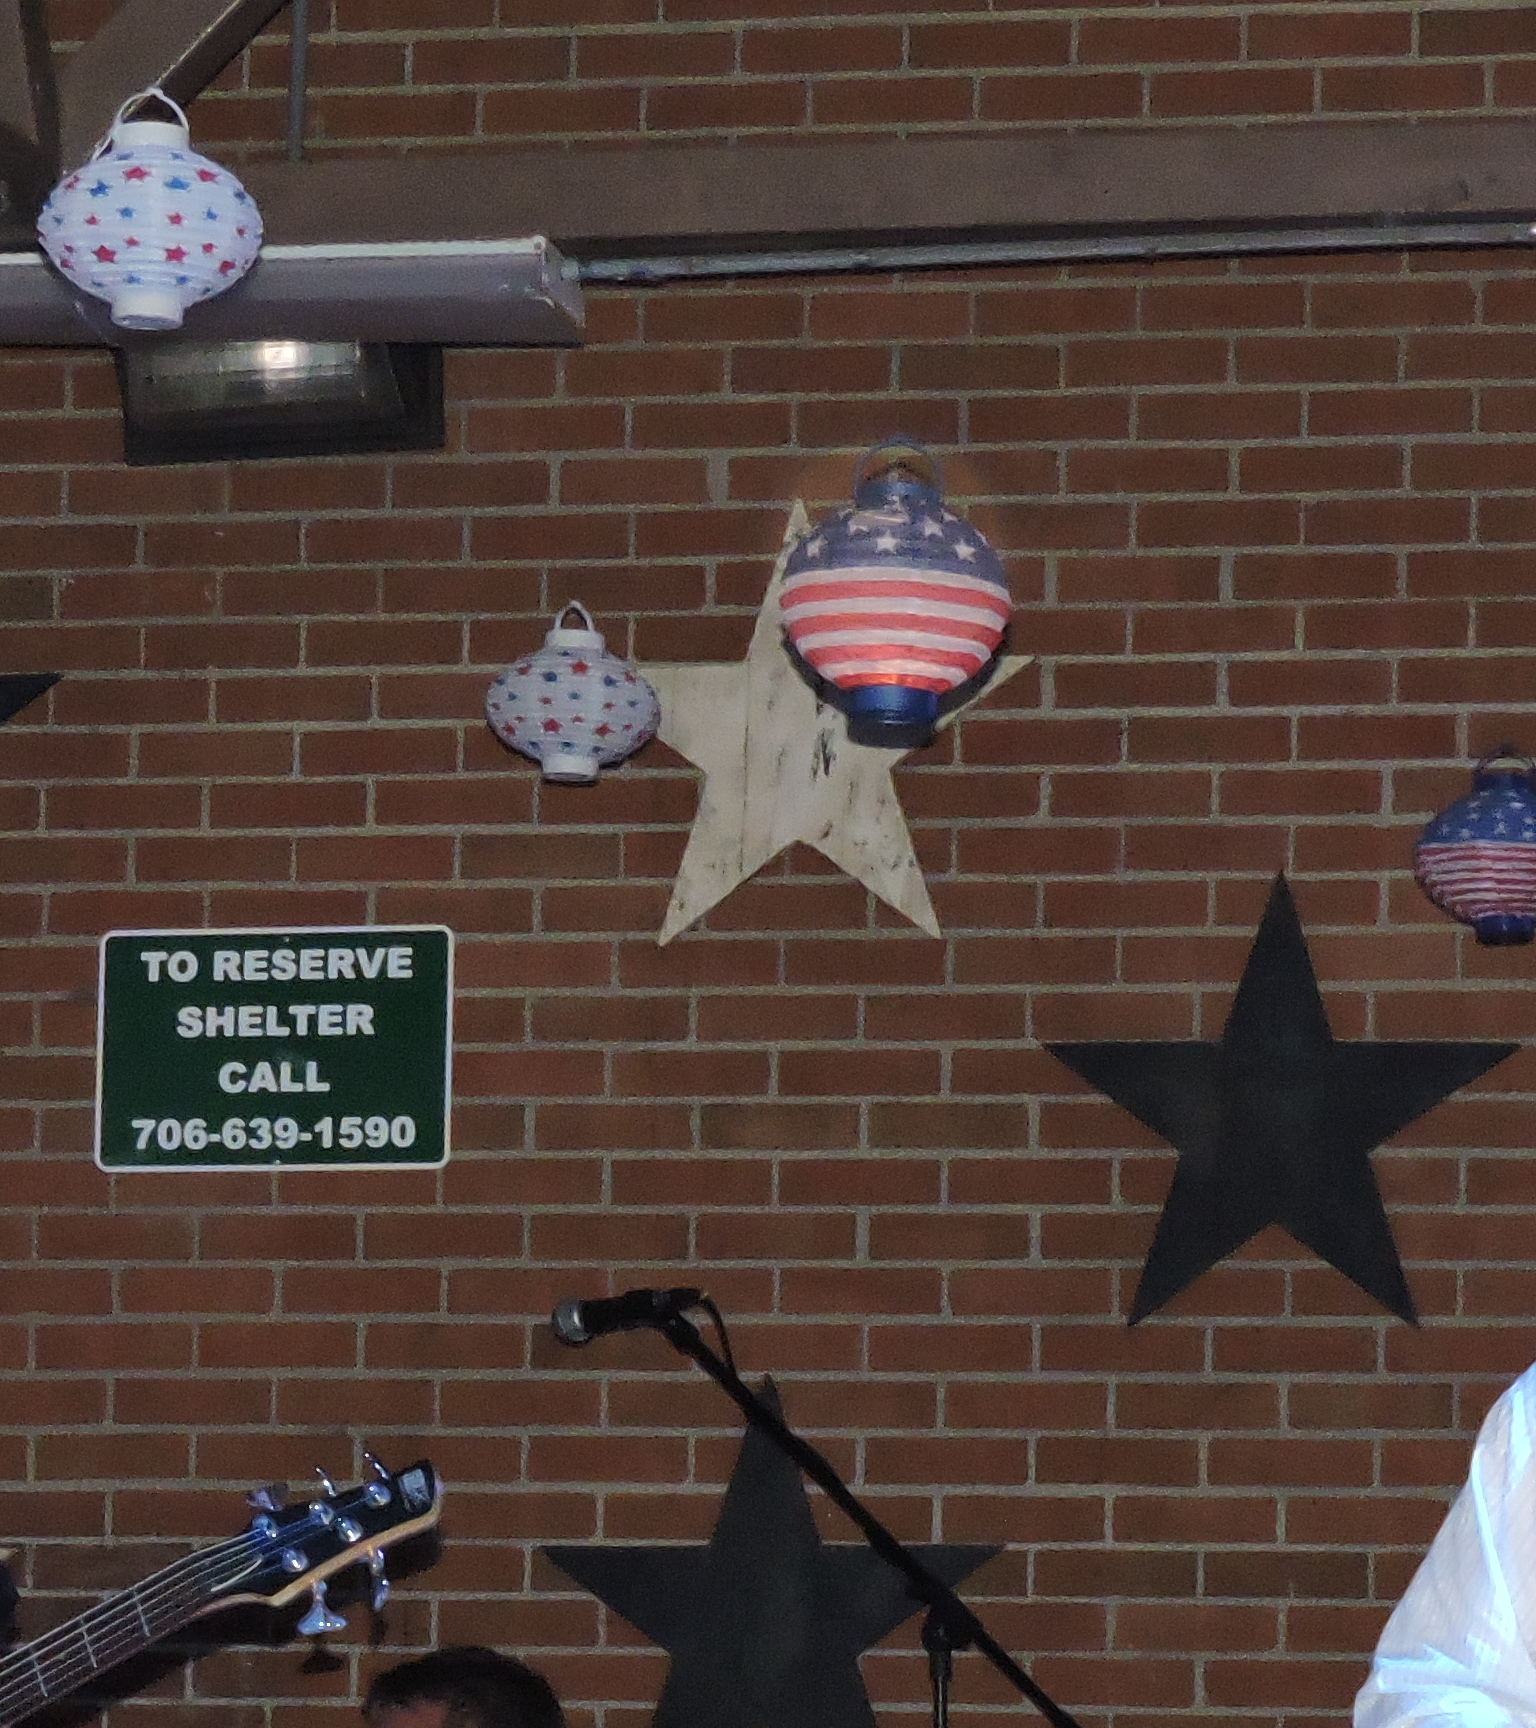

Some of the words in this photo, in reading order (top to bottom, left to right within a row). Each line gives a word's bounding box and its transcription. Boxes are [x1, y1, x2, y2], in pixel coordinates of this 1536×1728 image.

[140, 950, 198, 983] TO
[213, 946, 414, 982] RESERVE
[176, 1004, 375, 1039] SHELTER
[217, 1061, 331, 1094] CALL
[131, 1115, 416, 1150] 706-639-1590
